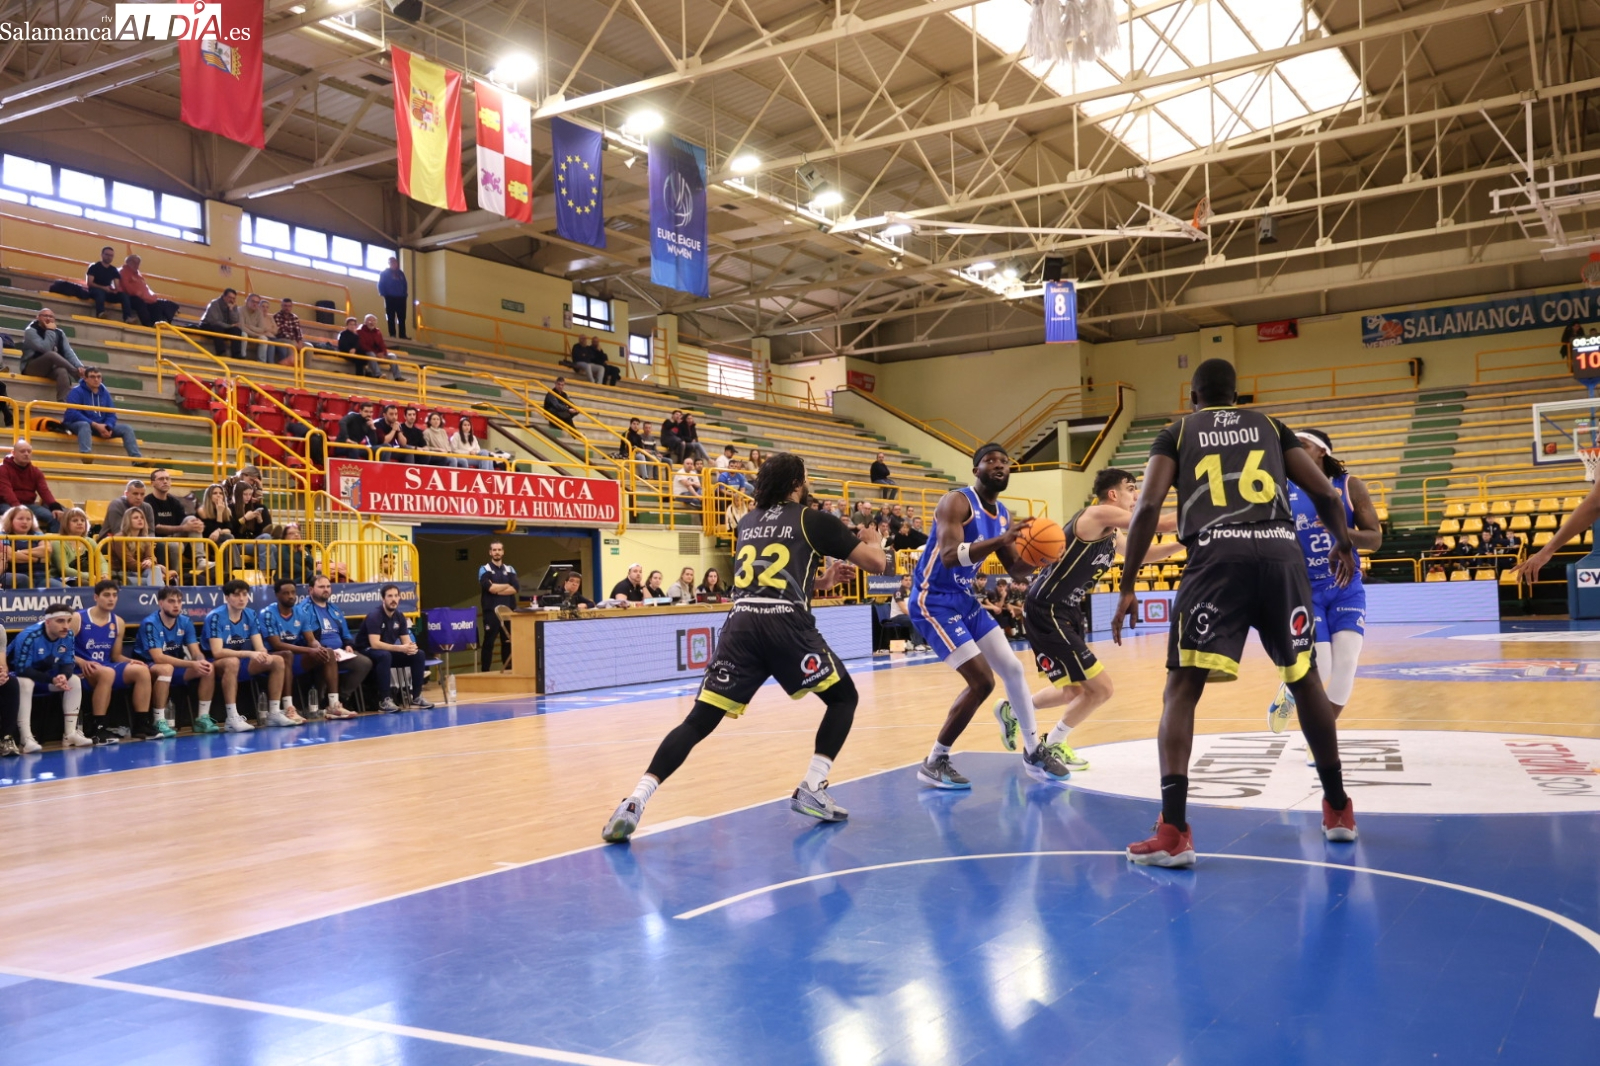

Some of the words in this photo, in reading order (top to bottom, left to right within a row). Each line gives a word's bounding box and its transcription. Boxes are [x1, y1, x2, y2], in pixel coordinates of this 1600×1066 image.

[1055, 294, 1066, 316] 8
[1403, 303, 1536, 339] SALAMANCA
[1541, 296, 1590, 323] CON
[1576, 351, 1600, 370] 10
[1198, 427, 1260, 448] DOUDOU
[404, 467, 594, 501] SALAMANCA
[1194, 450, 1277, 507] 16
[369, 492, 479, 516] PATRIMONIO
[483, 499, 505, 516] DE
[509, 500, 529, 518] LA
[532, 501, 615, 520] HUMANIDAD
[741, 525, 777, 542] TEASLEY
[777, 525, 795, 539] JR.
[1212, 528, 1253, 539] trouw
[1309, 533, 1332, 553] 23
[734, 543, 791, 590] 32
[0, 595, 84, 612] LAMANCA
[209, 592, 219, 607] Y
